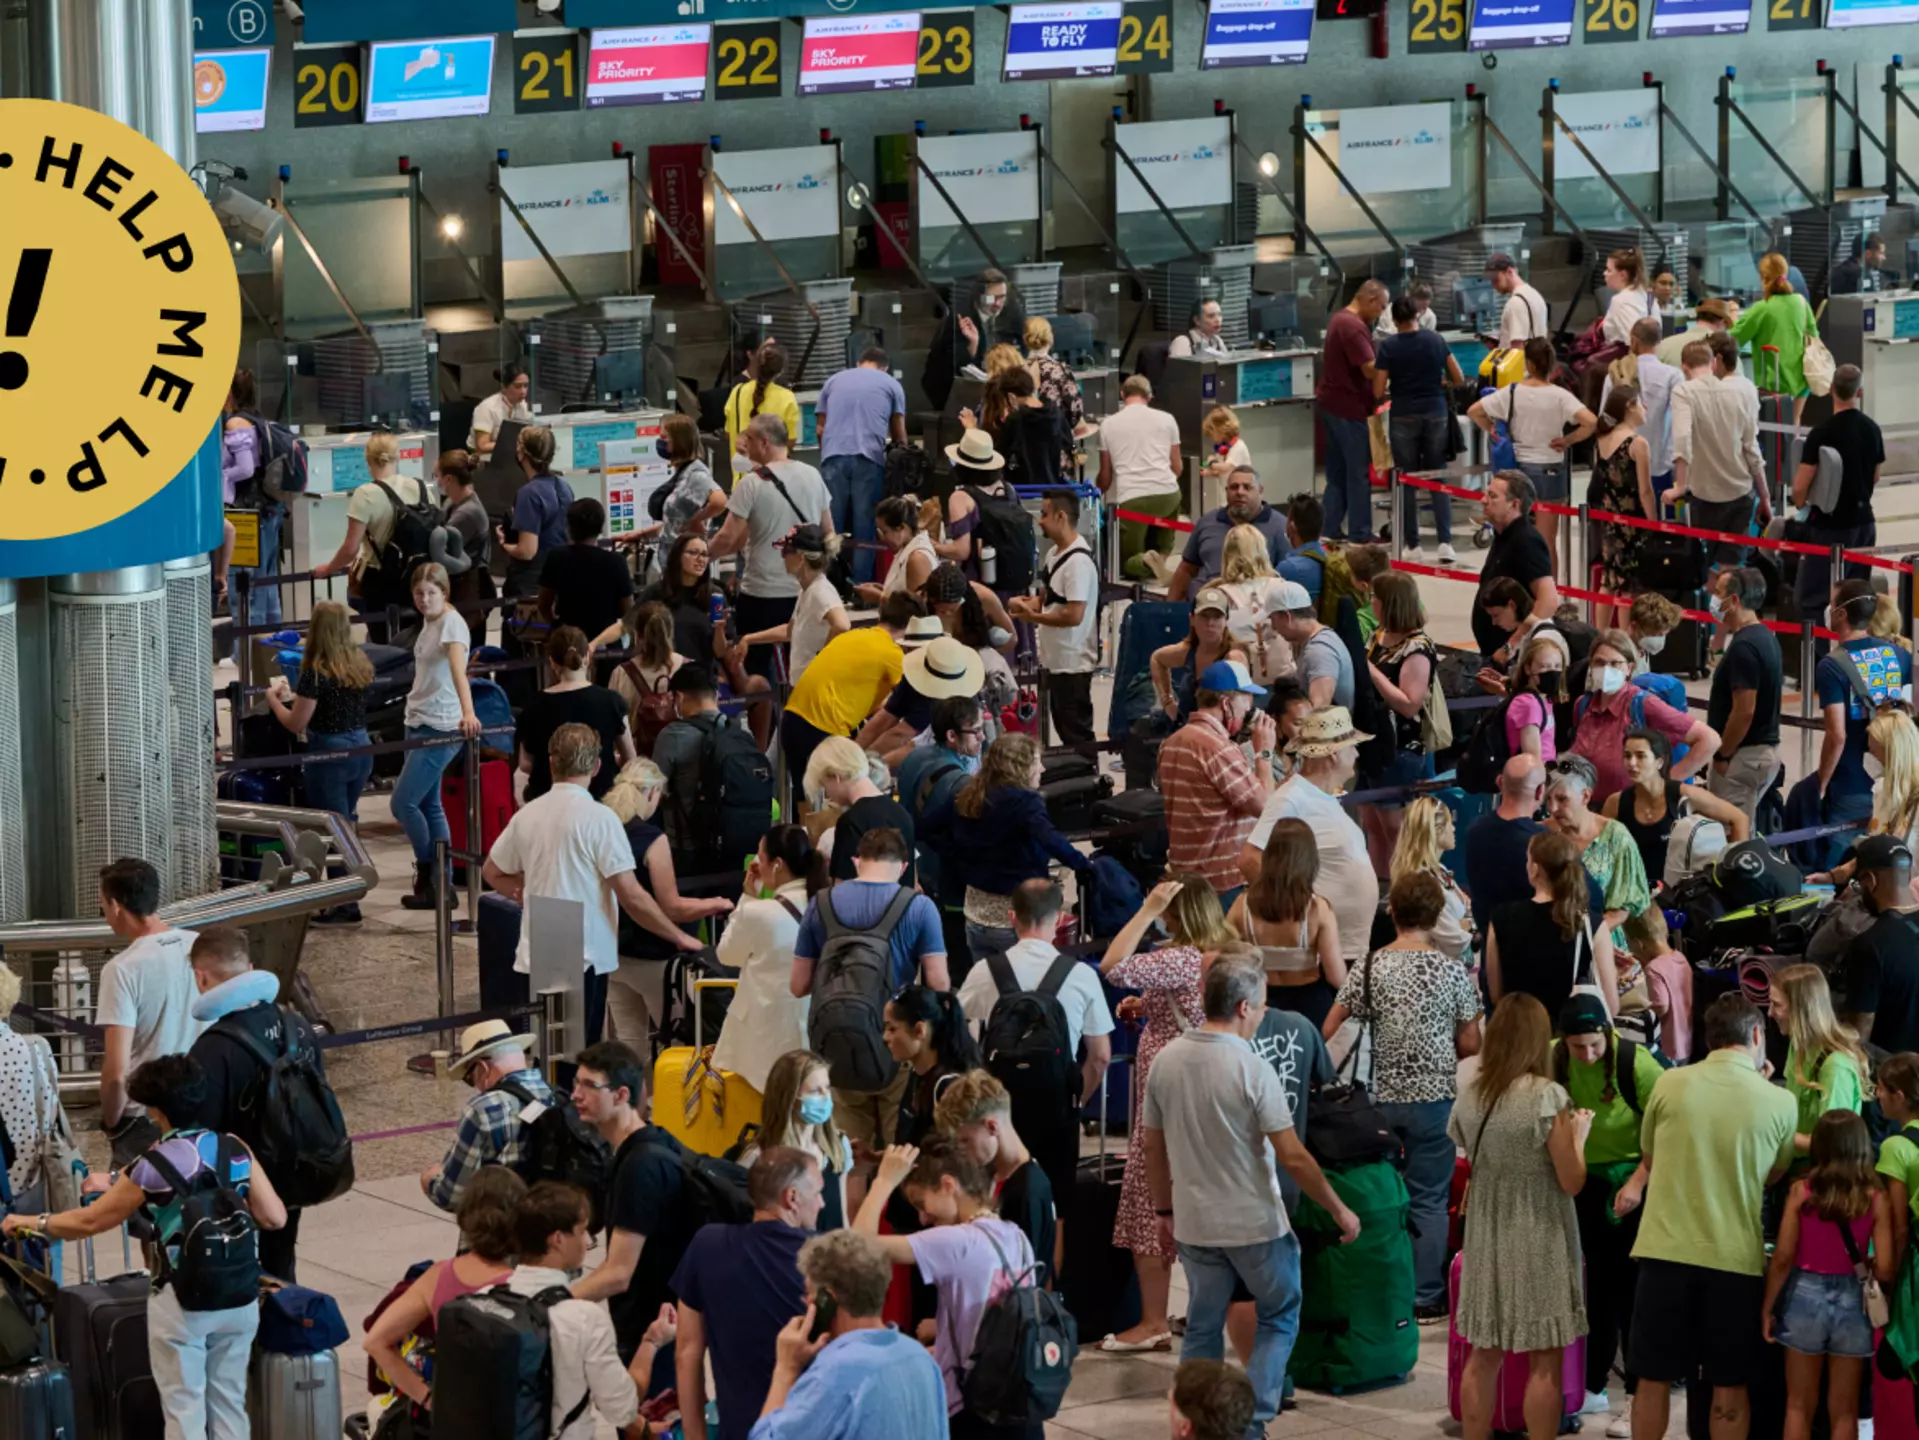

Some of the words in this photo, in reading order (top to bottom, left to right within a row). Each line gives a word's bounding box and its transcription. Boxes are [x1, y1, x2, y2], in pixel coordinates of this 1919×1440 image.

[239, 9, 257, 34] B
[1411, 0, 1464, 41] 25
[1586, 0, 1637, 31] 26
[1041, 24, 1088, 37] READY
[1041, 36, 1059, 48] TO
[1061, 34, 1086, 47] FLY
[1117, 15, 1171, 62] 24
[812, 48, 836, 58] SKY
[917, 26, 972, 74] 23
[598, 60, 624, 70] SKY
[717, 37, 778, 86] 22
[811, 55, 866, 67] PRIORITY
[520, 49, 573, 100] 21
[598, 67, 655, 80] PRIORITY
[297, 62, 359, 114] 20
[1192, 151, 1213, 160] KLM
[997, 165, 1020, 175] KLM
[797, 179, 819, 190] KLM
[586, 195, 610, 205] KLM
